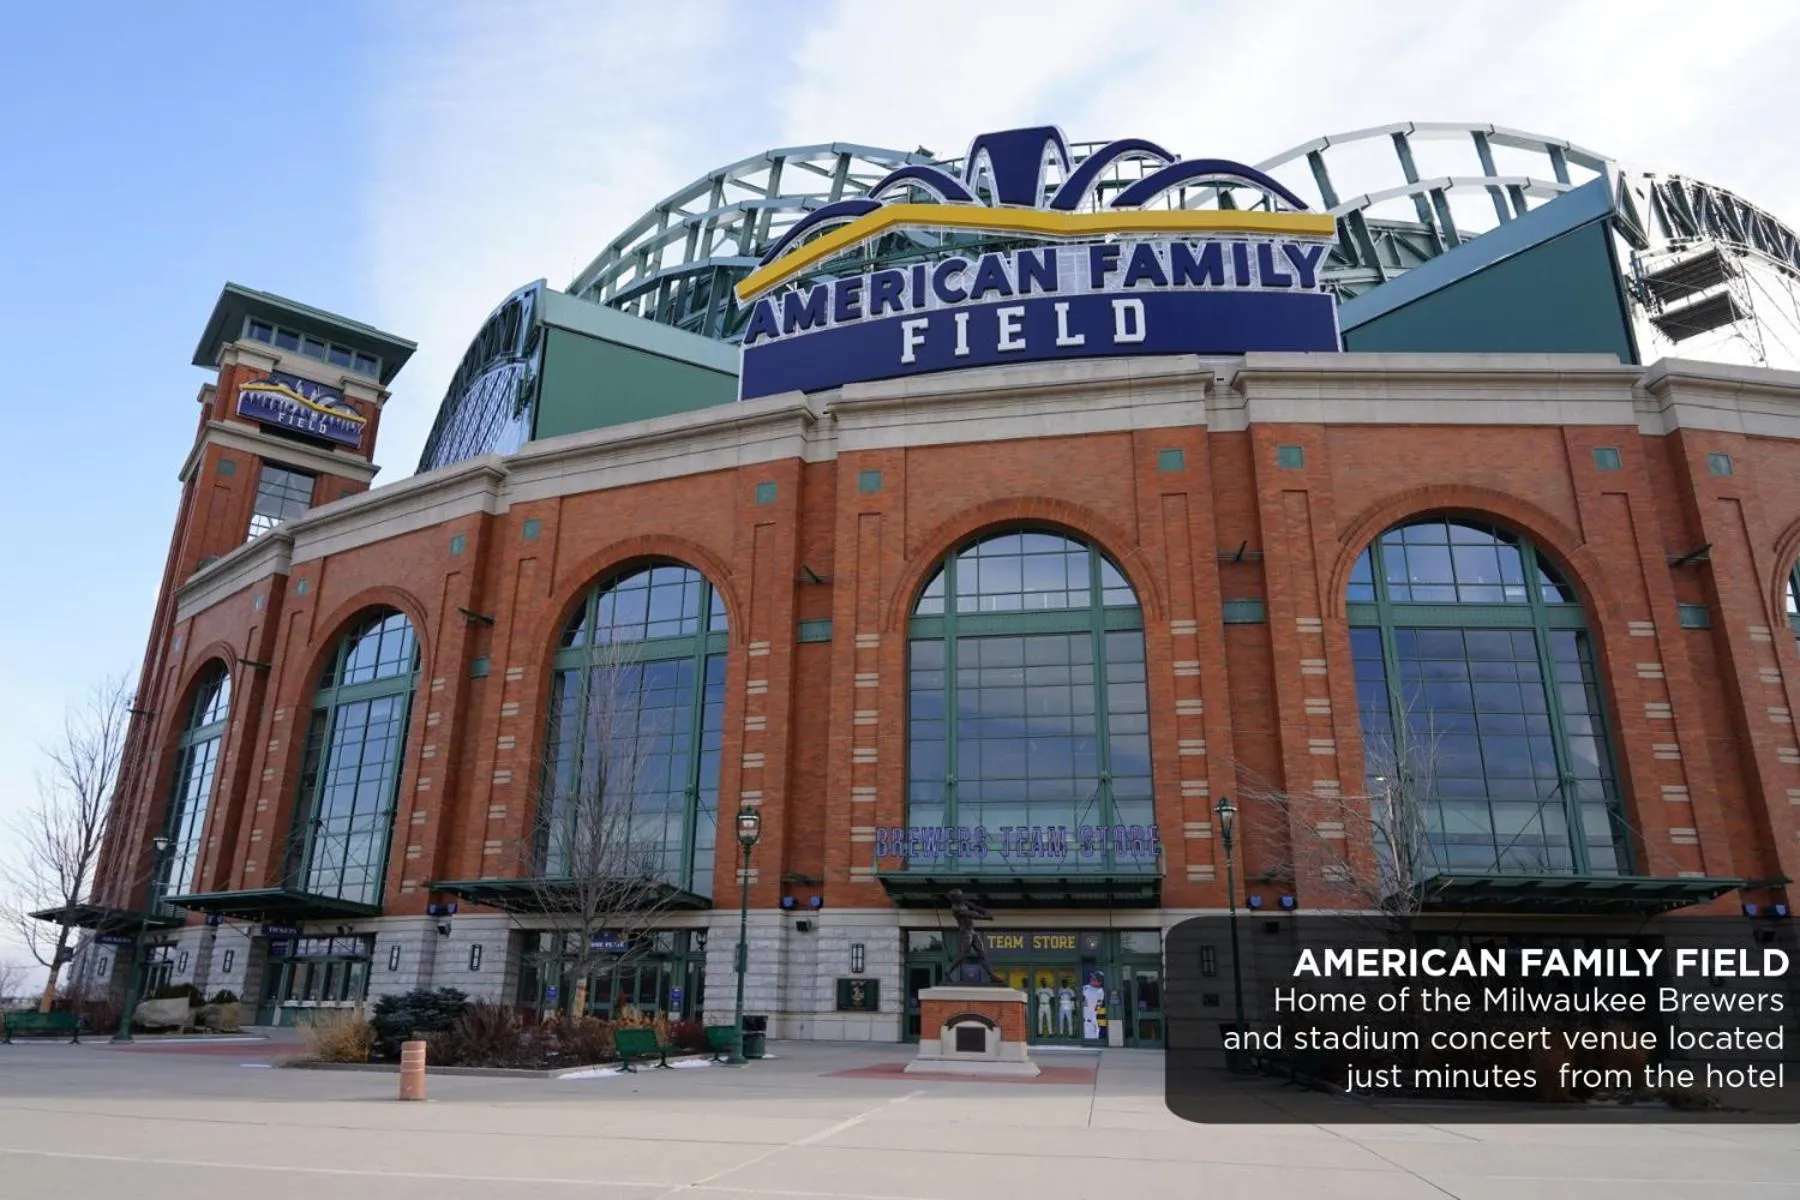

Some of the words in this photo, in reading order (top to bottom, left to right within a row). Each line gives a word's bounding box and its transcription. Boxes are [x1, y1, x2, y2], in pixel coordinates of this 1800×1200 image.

[743, 247, 1059, 344] AMERICAN
[1090, 241, 1324, 289] FAMILY
[901, 298, 1146, 364] FIELD
[244, 392, 312, 420] AMERICAN
[278, 413, 327, 434] FIELD
[875, 826, 988, 858] BREWERS
[1000, 826, 1067, 858] TEAM
[1080, 825, 1160, 857] STORE
[987, 935, 1024, 949] TEAM
[1033, 935, 1076, 949] STORE
